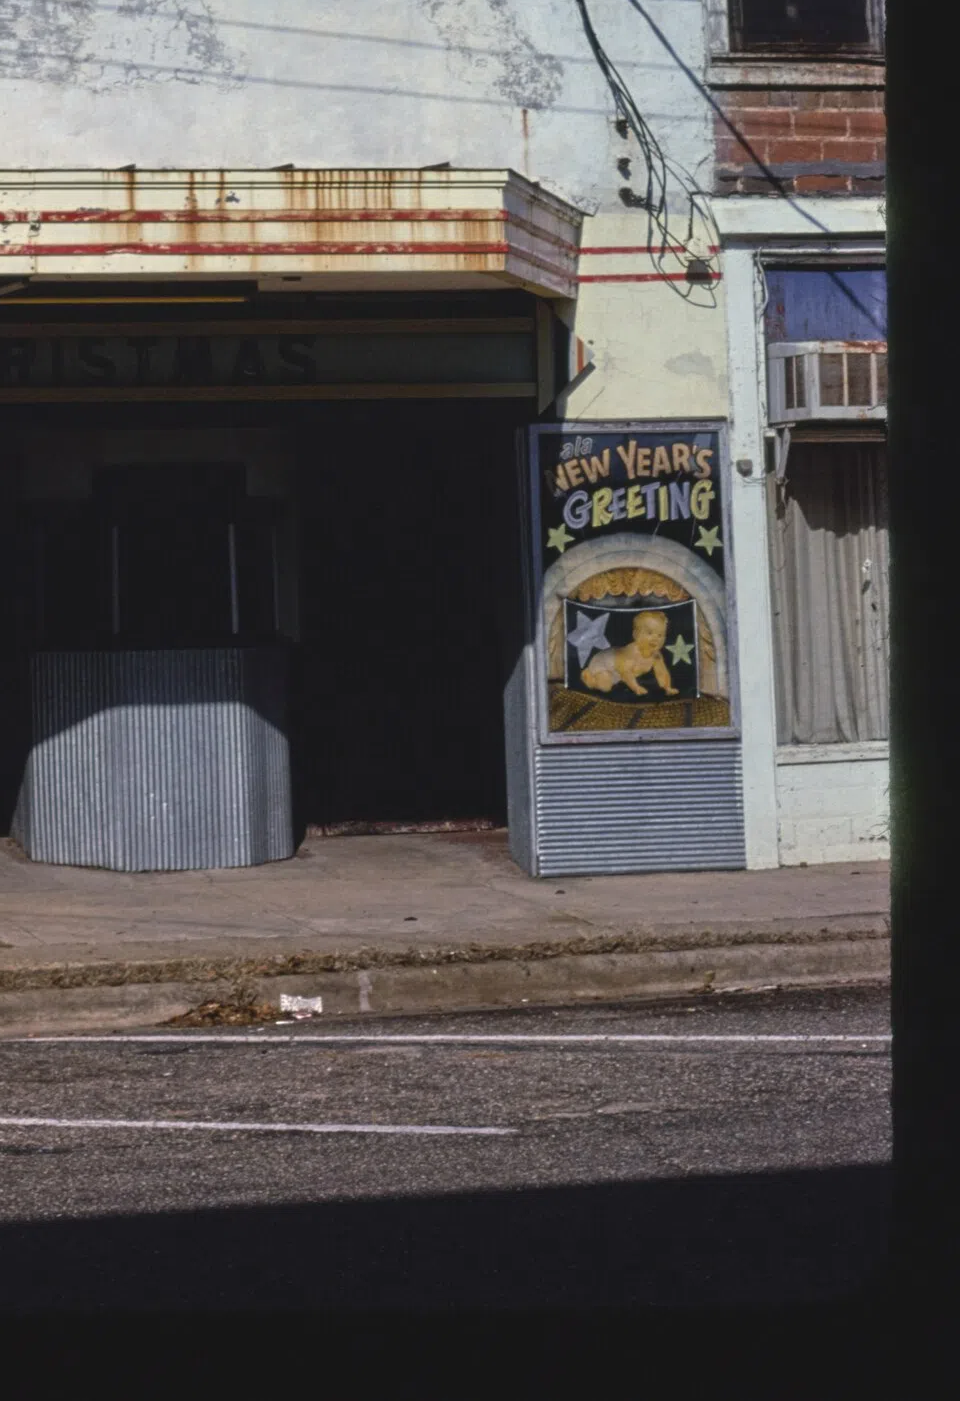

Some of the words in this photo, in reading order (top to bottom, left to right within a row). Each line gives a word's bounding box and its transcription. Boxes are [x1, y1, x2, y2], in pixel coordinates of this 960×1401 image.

[547, 448, 611, 496] NEW
[616, 438, 714, 479] YEAR'S
[563, 479, 716, 529] GREETING
